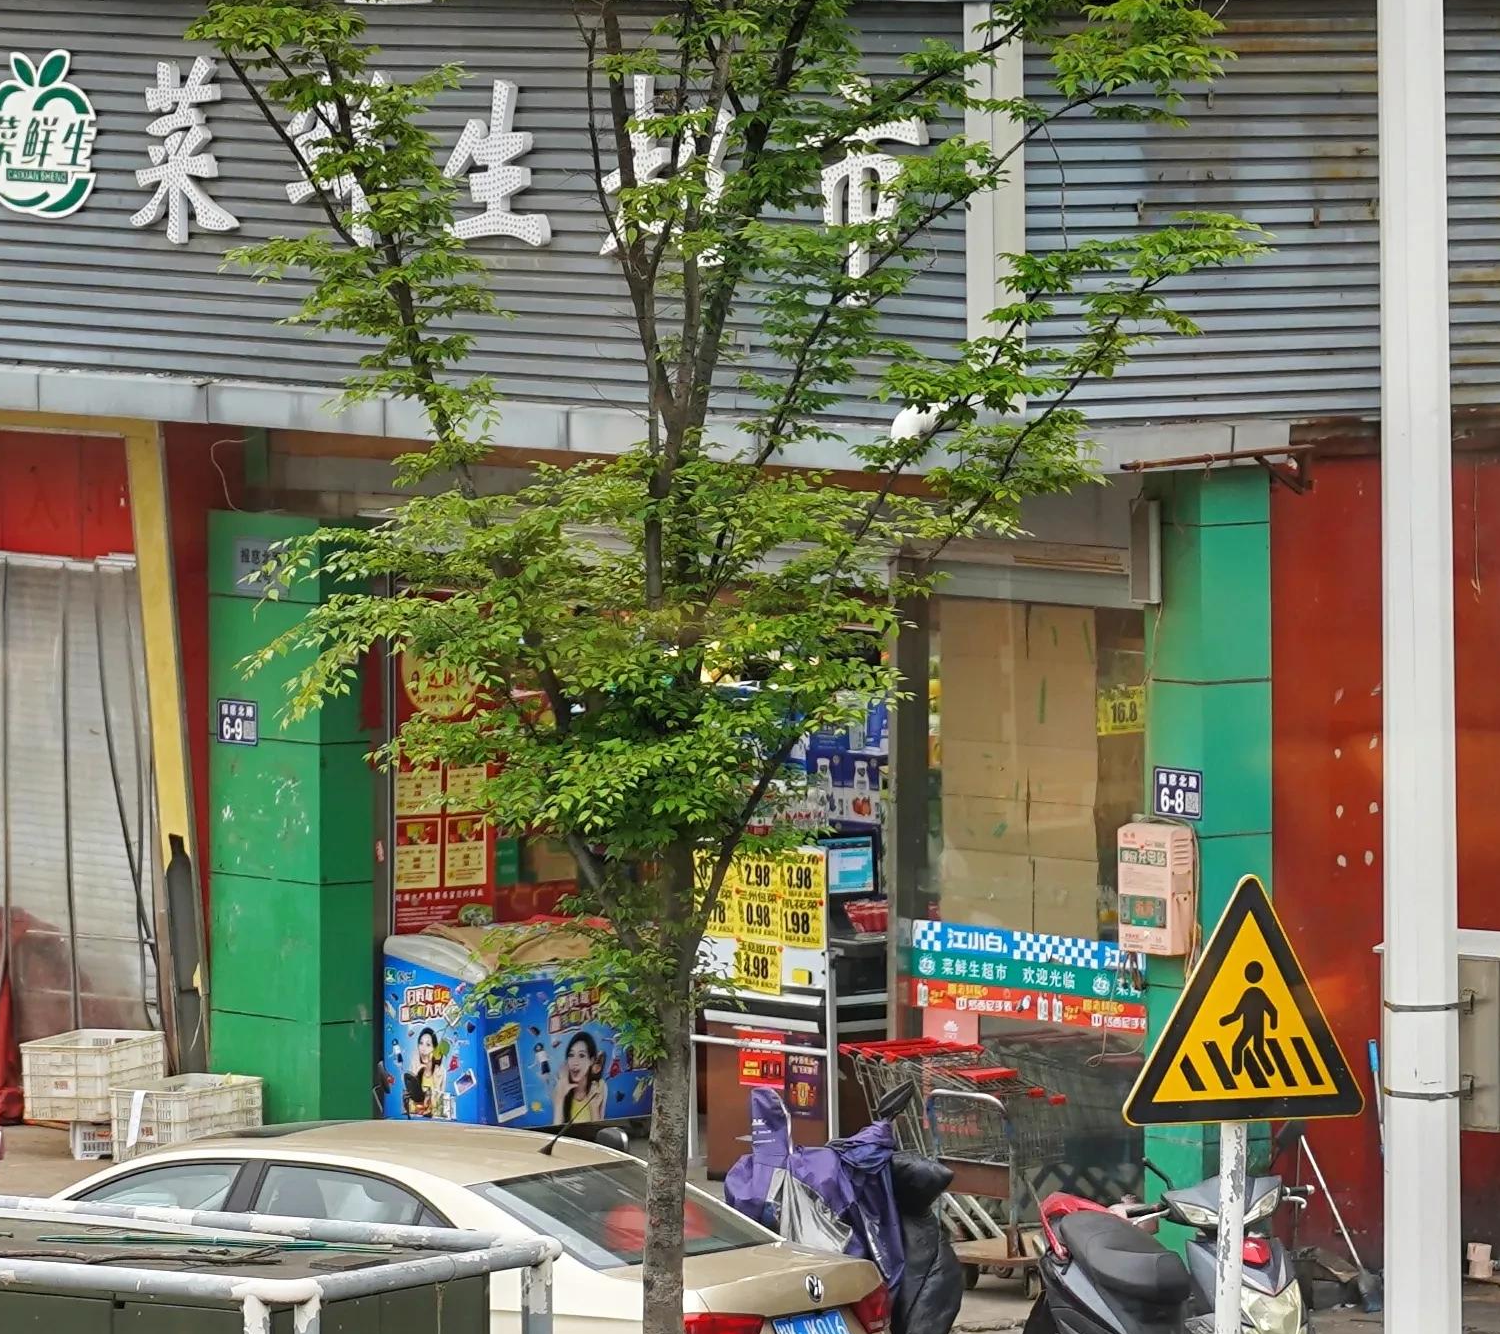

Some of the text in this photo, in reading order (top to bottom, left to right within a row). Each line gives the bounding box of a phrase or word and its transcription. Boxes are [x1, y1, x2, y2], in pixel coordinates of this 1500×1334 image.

[1111, 701, 1138, 723] 16.8
[223, 717, 243, 740] 6-9
[1160, 787, 1184, 813] 6-8
[745, 863, 770, 887] 2.98
[787, 865, 812, 889] 3.98
[746, 903, 770, 928] 0.98
[784, 911, 810, 934] 1.98
[946, 928, 1007, 953] 江小白
[744, 956, 769, 979] 4.98
[942, 958, 1076, 989] 菜鲜生超市 欢迎光临
